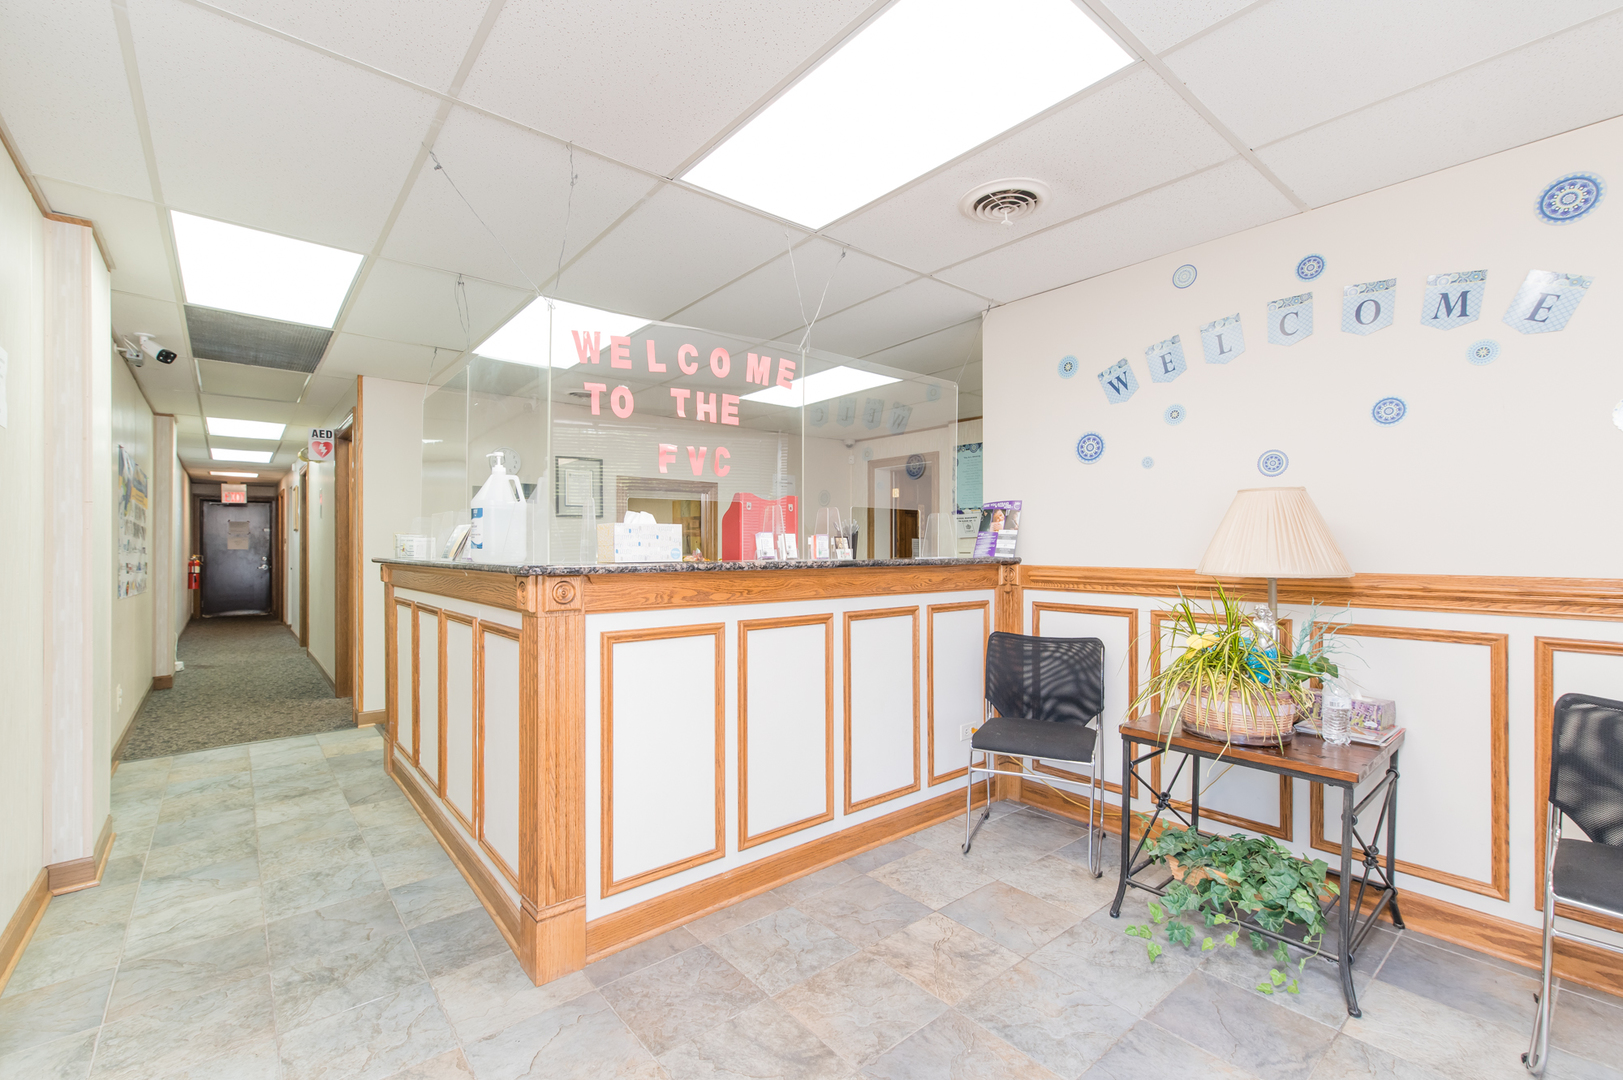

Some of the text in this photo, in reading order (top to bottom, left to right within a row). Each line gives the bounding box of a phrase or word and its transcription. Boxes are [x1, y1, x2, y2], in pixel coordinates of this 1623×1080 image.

[571, 330, 796, 390] WELCOME
[1107, 290, 1560, 396] WELCOME
[583, 381, 740, 425] TO THE
[311, 429, 333, 439] AED
[658, 443, 731, 477] FVC
